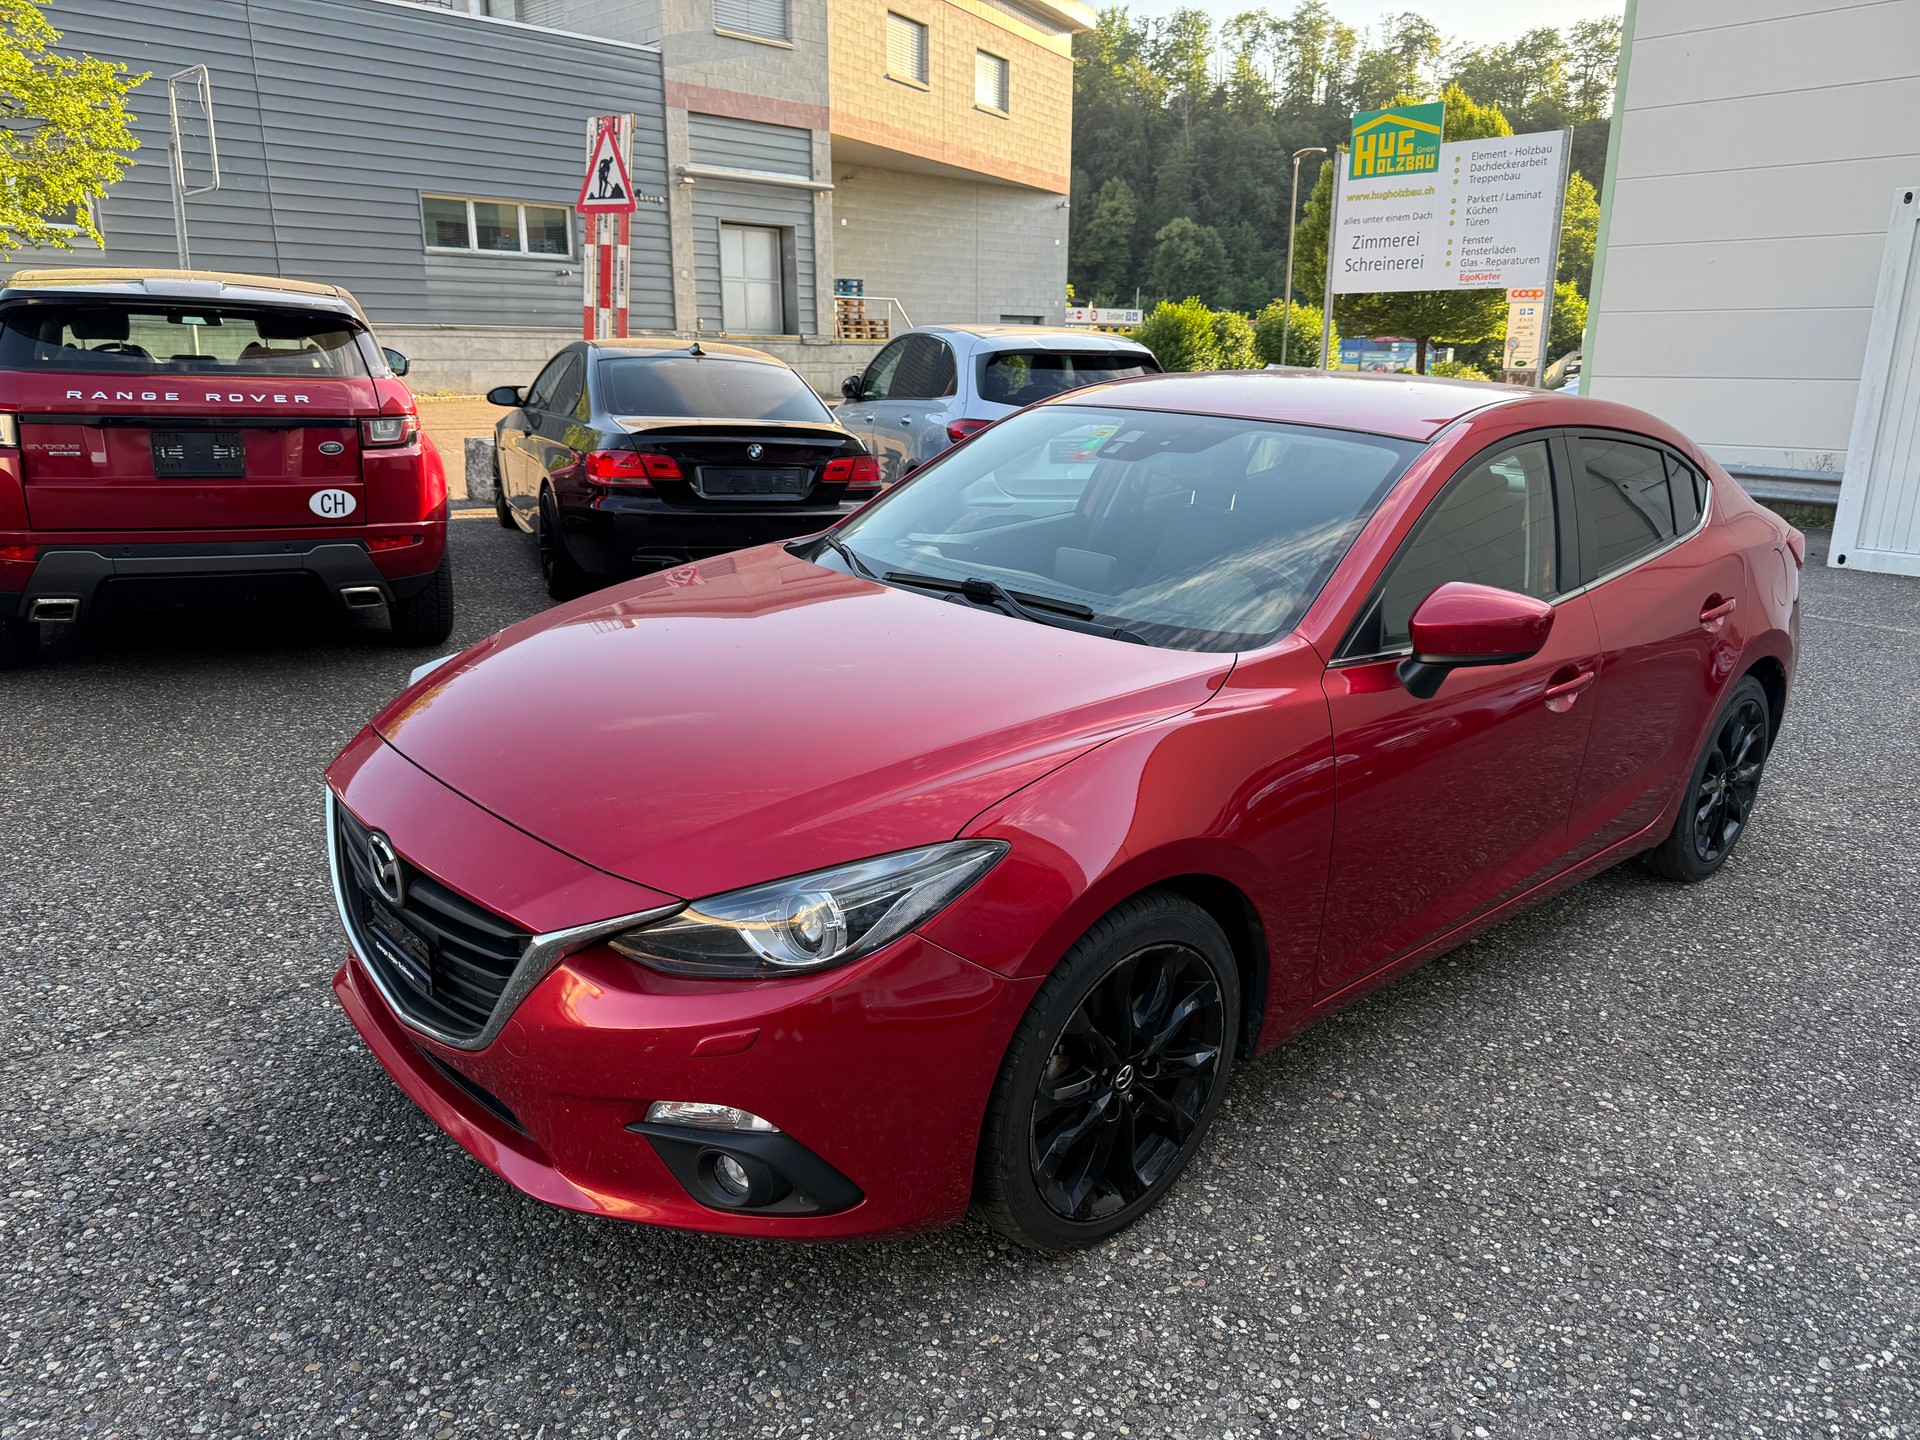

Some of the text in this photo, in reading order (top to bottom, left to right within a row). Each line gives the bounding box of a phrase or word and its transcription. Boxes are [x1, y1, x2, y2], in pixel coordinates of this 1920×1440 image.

[1353, 130, 1436, 176] HUG GmbH
[1471, 149, 1507, 160] Element
[1515, 145, 1552, 156] Holzbau
[1470, 157, 1547, 172] Dachdeckerarbeit
[1469, 172, 1521, 184] Treppenbau
[1346, 186, 1435, 202] www.hugholzbau.ch
[1467, 194, 1498, 204] Parkett
[1505, 191, 1542, 201] Laminat
[1466, 206, 1498, 215] Küchen
[1344, 211, 1433, 225] alles unter einem Dach
[1465, 218, 1490, 227] Türen
[1352, 231, 1420, 250] Zimmerei
[1462, 236, 1493, 245] Fenster
[1461, 245, 1516, 256] Fensterläden
[1345, 254, 1424, 272] Schreinerei
[1460, 258, 1478, 267] Glas
[1485, 256, 1540, 267] Reparaturen
[1459, 272, 1501, 282] EgoKiefer
[1511, 289, 1544, 300] coop
[66, 390, 310, 403] RANGE ROVER
[320, 493, 345, 514] CH
